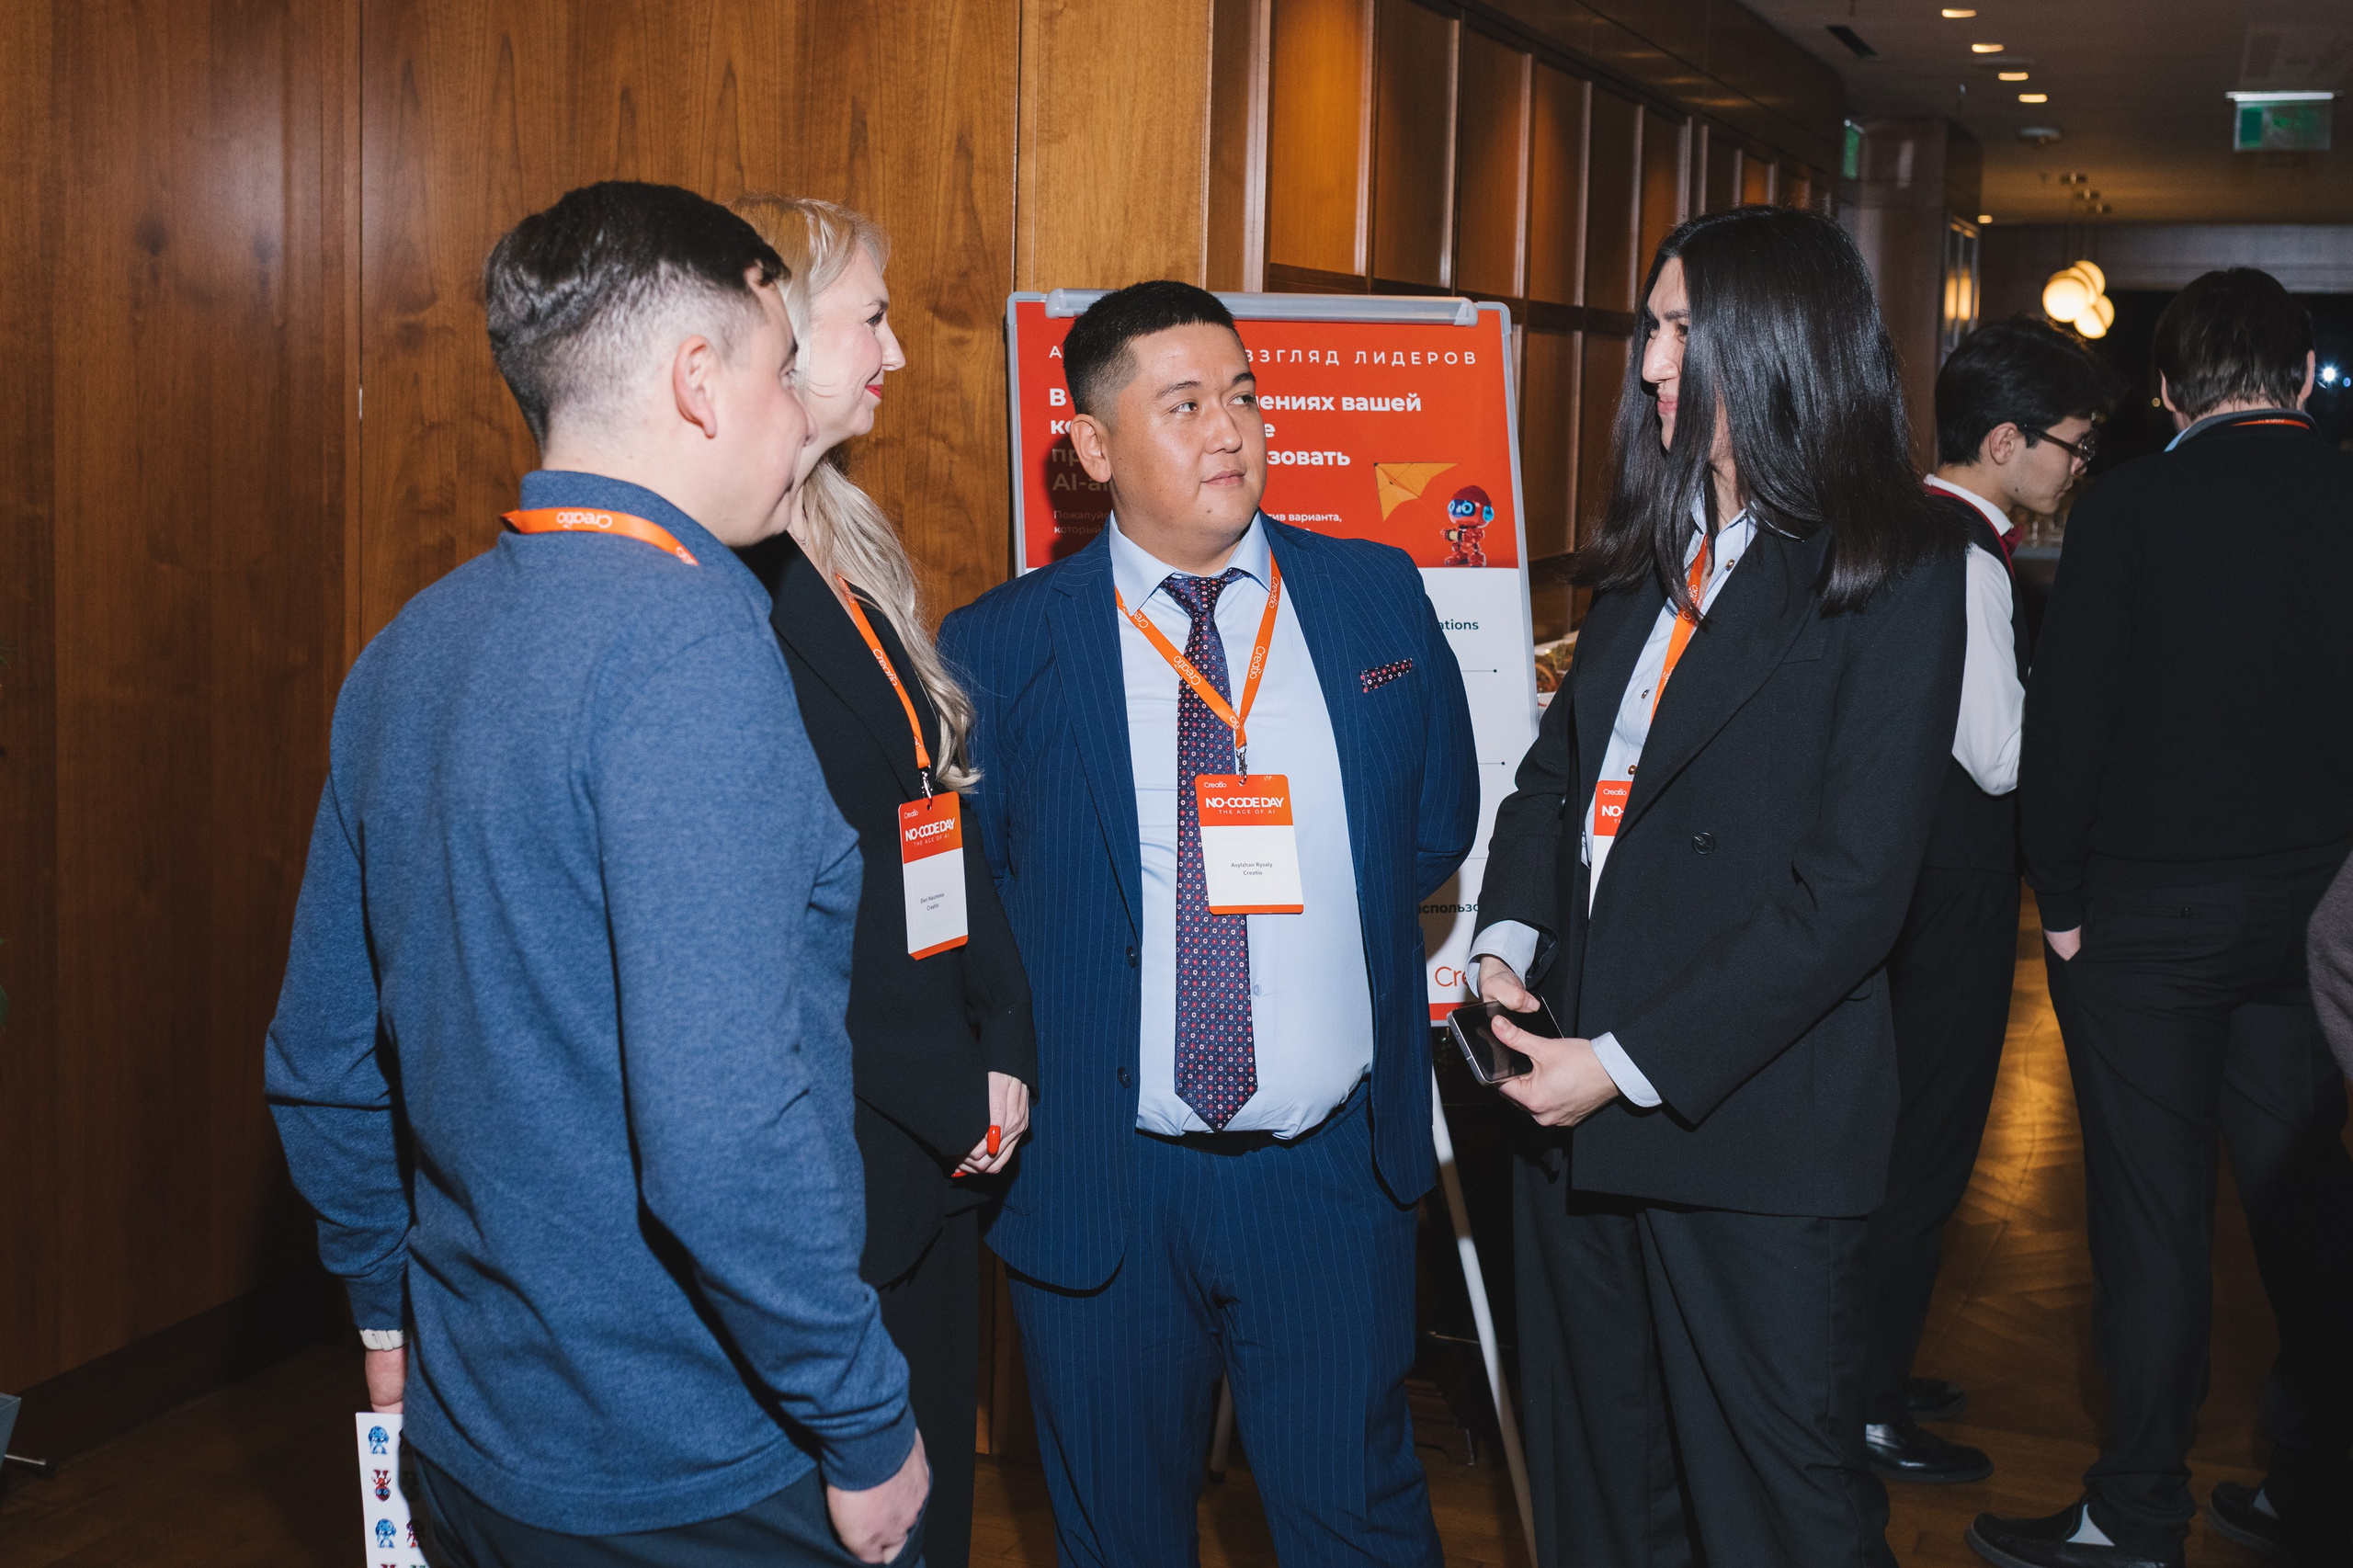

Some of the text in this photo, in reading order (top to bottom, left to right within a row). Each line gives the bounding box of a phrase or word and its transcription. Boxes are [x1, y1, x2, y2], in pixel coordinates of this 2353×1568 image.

[1245, 348, 1340, 366] ВЗГЛЯД
[1354, 350, 1476, 367] ЛИДЕРОВ
[1256, 394, 1336, 411] ениях
[1341, 392, 1423, 412] вашей
[1266, 450, 1351, 466] зовать
[556, 511, 613, 530] Creatio
[1288, 513, 1343, 523] варианта,
[872, 648, 898, 687] Creatio
[1173, 654, 1201, 687] Creatio
[1248, 645, 1267, 680] Creatio
[1602, 788, 1628, 796] Creatio
[1205, 797, 1284, 809] NO-CODE DAY
[904, 817, 956, 843] NO-CODE DAY
